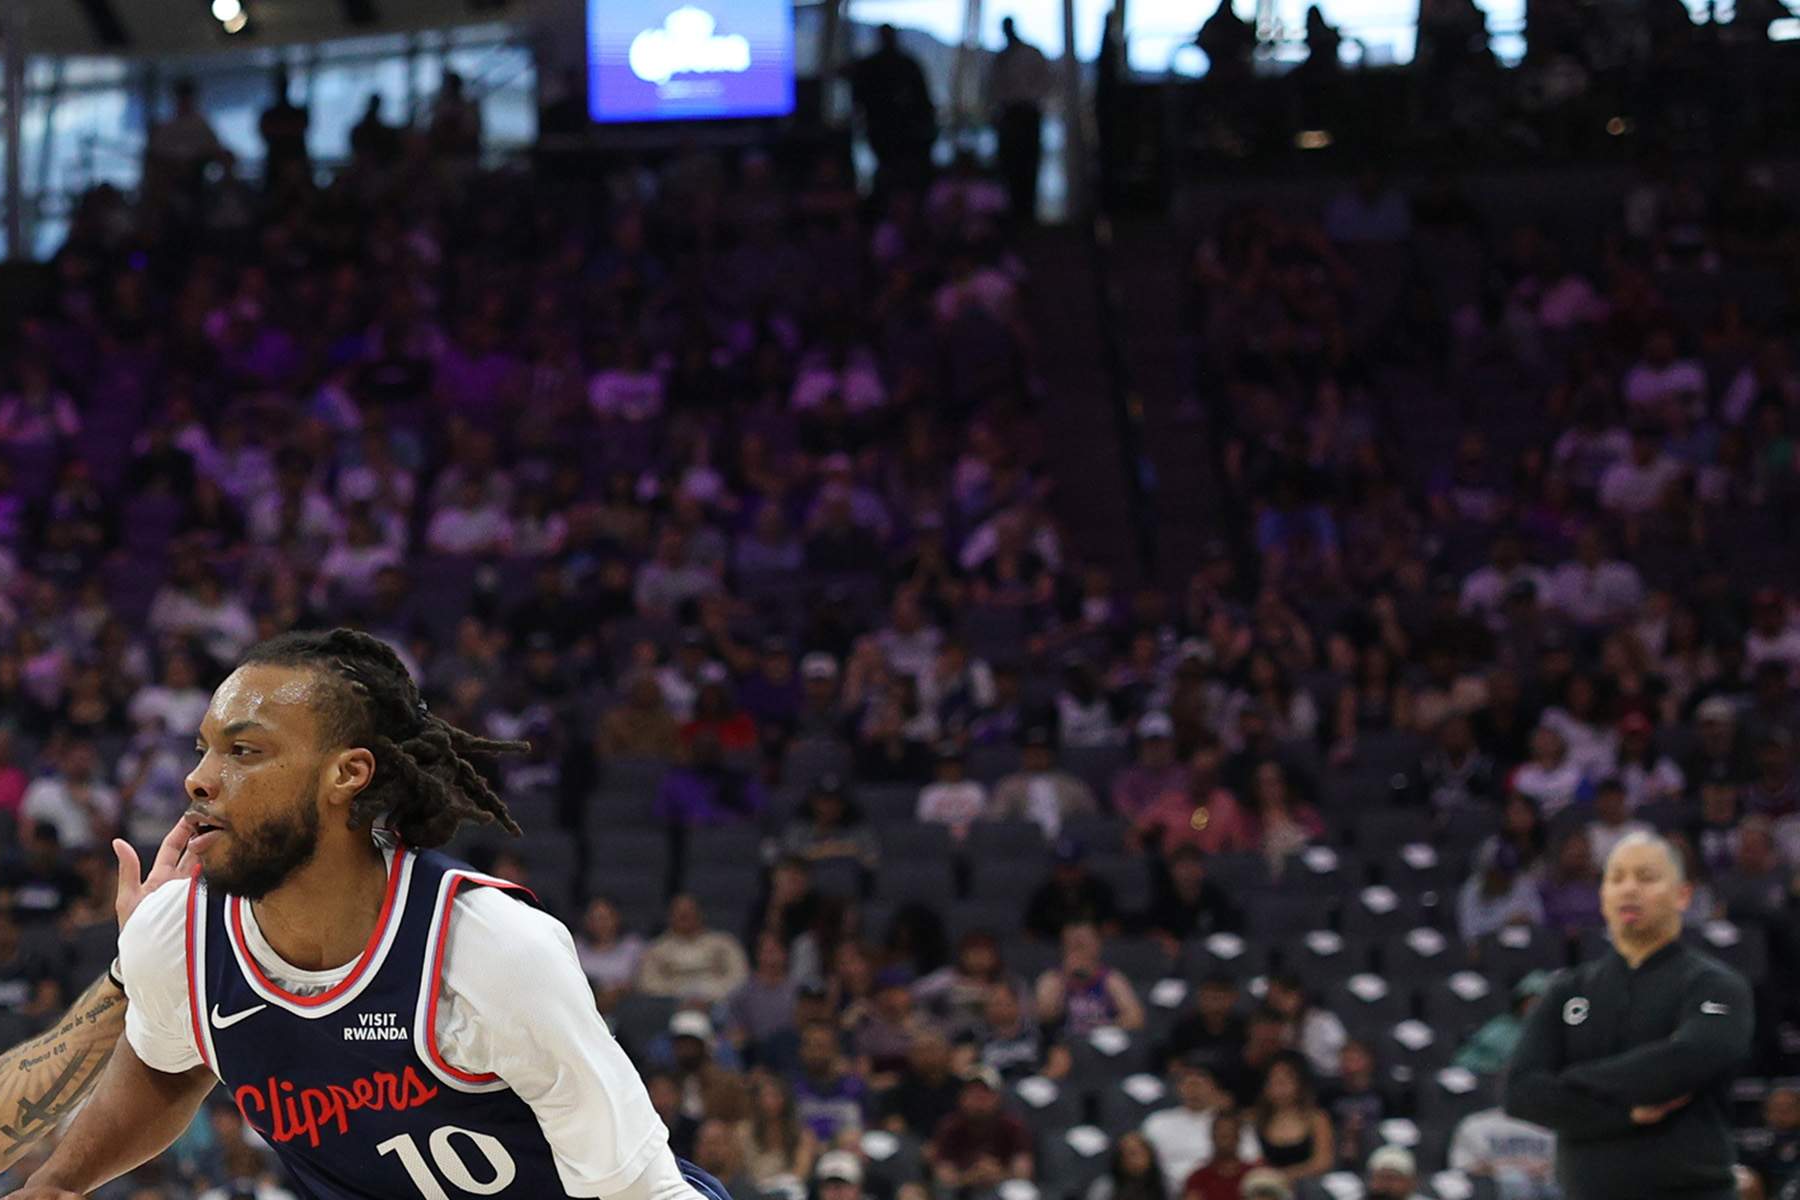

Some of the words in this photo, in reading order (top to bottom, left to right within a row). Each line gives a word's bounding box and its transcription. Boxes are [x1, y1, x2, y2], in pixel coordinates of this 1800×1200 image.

[358, 1013, 397, 1027] VISIT
[343, 1027, 408, 1041] RWANDA
[235, 1065, 438, 1149] Clippers
